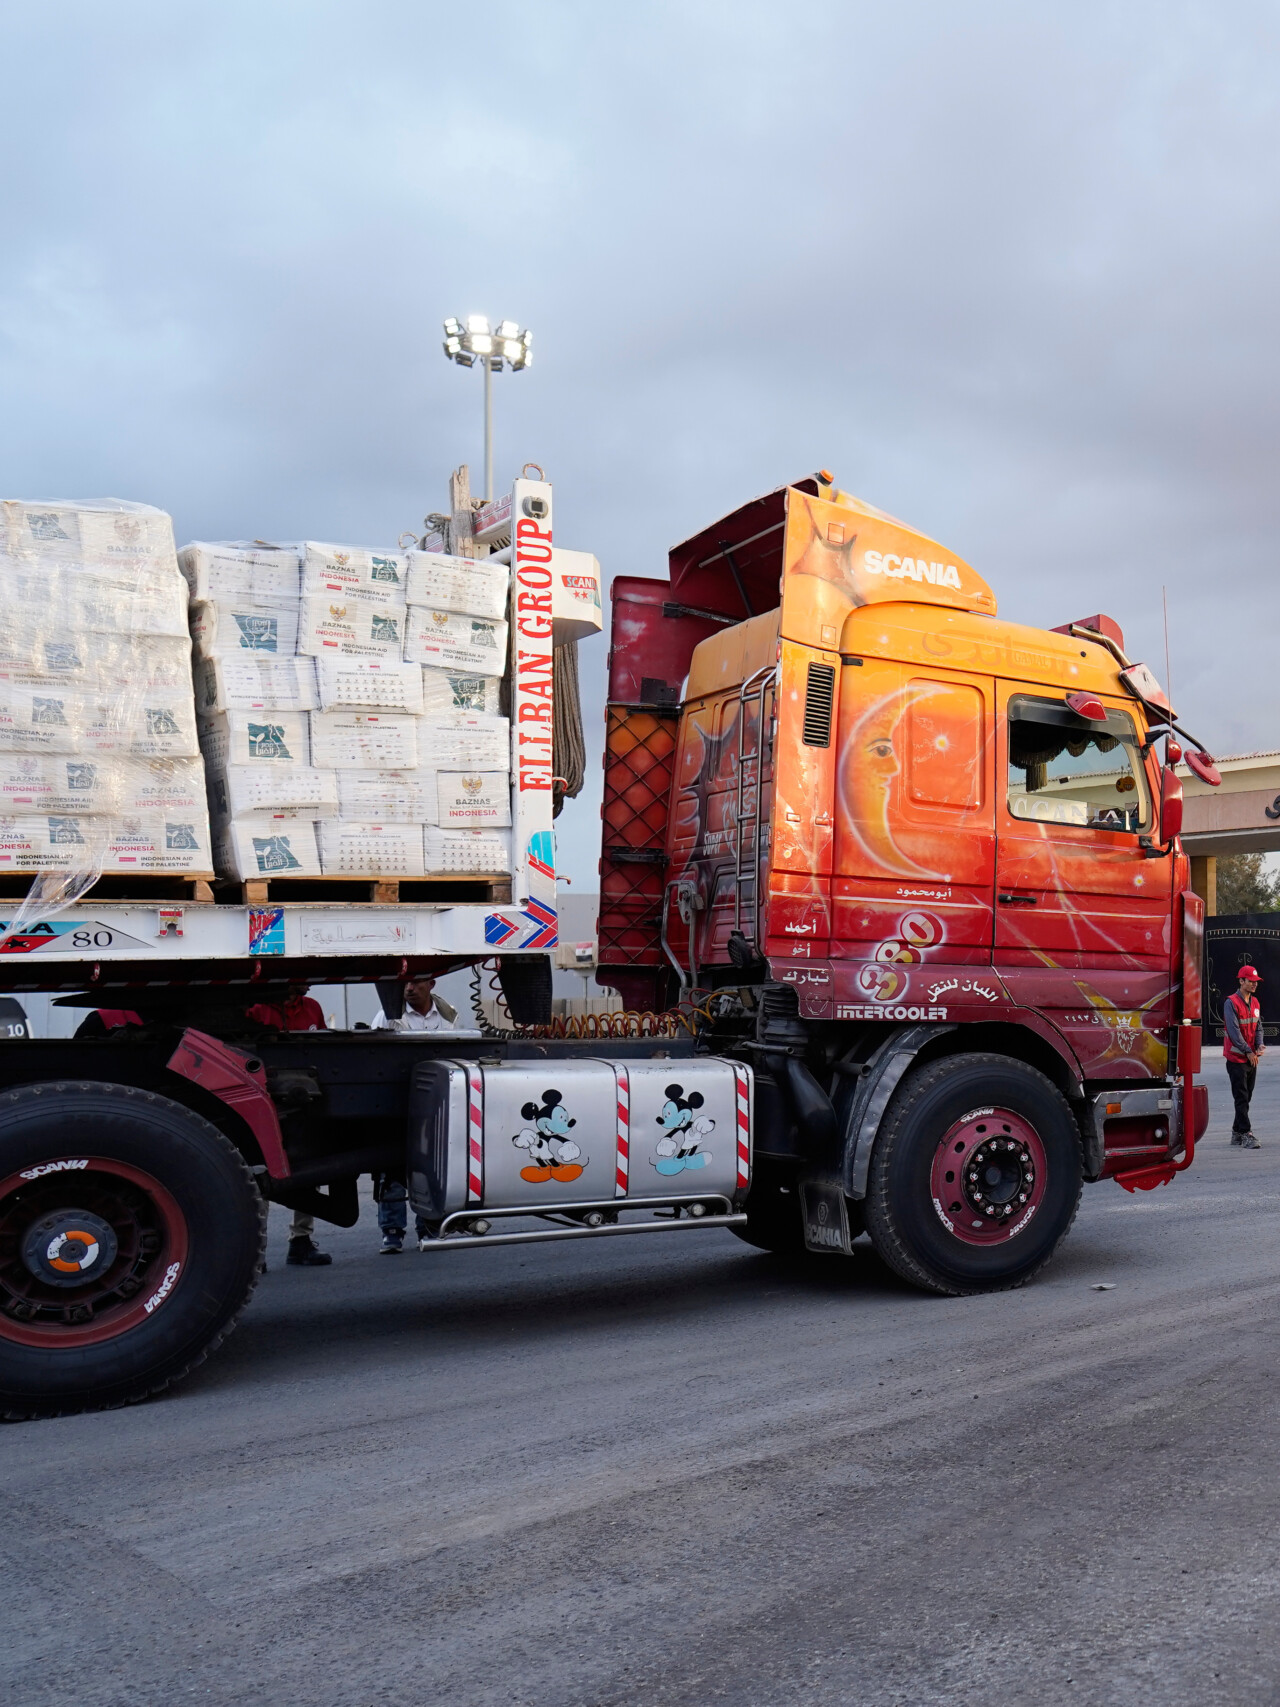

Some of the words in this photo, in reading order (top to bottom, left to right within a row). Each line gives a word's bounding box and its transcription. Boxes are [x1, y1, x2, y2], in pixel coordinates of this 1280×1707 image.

[326, 564, 356, 574] BAZNAS
[864, 550, 961, 589] SCANIA
[320, 572, 360, 584] INDONESIA
[517, 518, 553, 639] GROUP
[323, 621, 352, 630] BAZNAS
[425, 626, 453, 636] BAZNAS
[316, 630, 356, 641] INDONESIA
[419, 634, 457, 645] INDONESIA
[518, 650, 553, 792] ELLBAN
[0, 727, 41, 737] NDONESIAN
[135, 799, 196, 808] INDONESIA
[449, 809, 498, 817] INDONESIA
[785, 919, 816, 934] أحمد
[72, 931, 113, 948] 80
[792, 943, 811, 958] أخو
[783, 969, 830, 986] تبارك
[927, 978, 959, 1003] للنقل
[961, 980, 999, 1002] اللبان
[8, 1024, 25, 1037] 10
[961, 1108, 994, 1123] SCANIA
[20, 1160, 89, 1180] SCANIA
[1010, 1205, 1036, 1237] SCANIA
[143, 1261, 181, 1314] SCANIA
